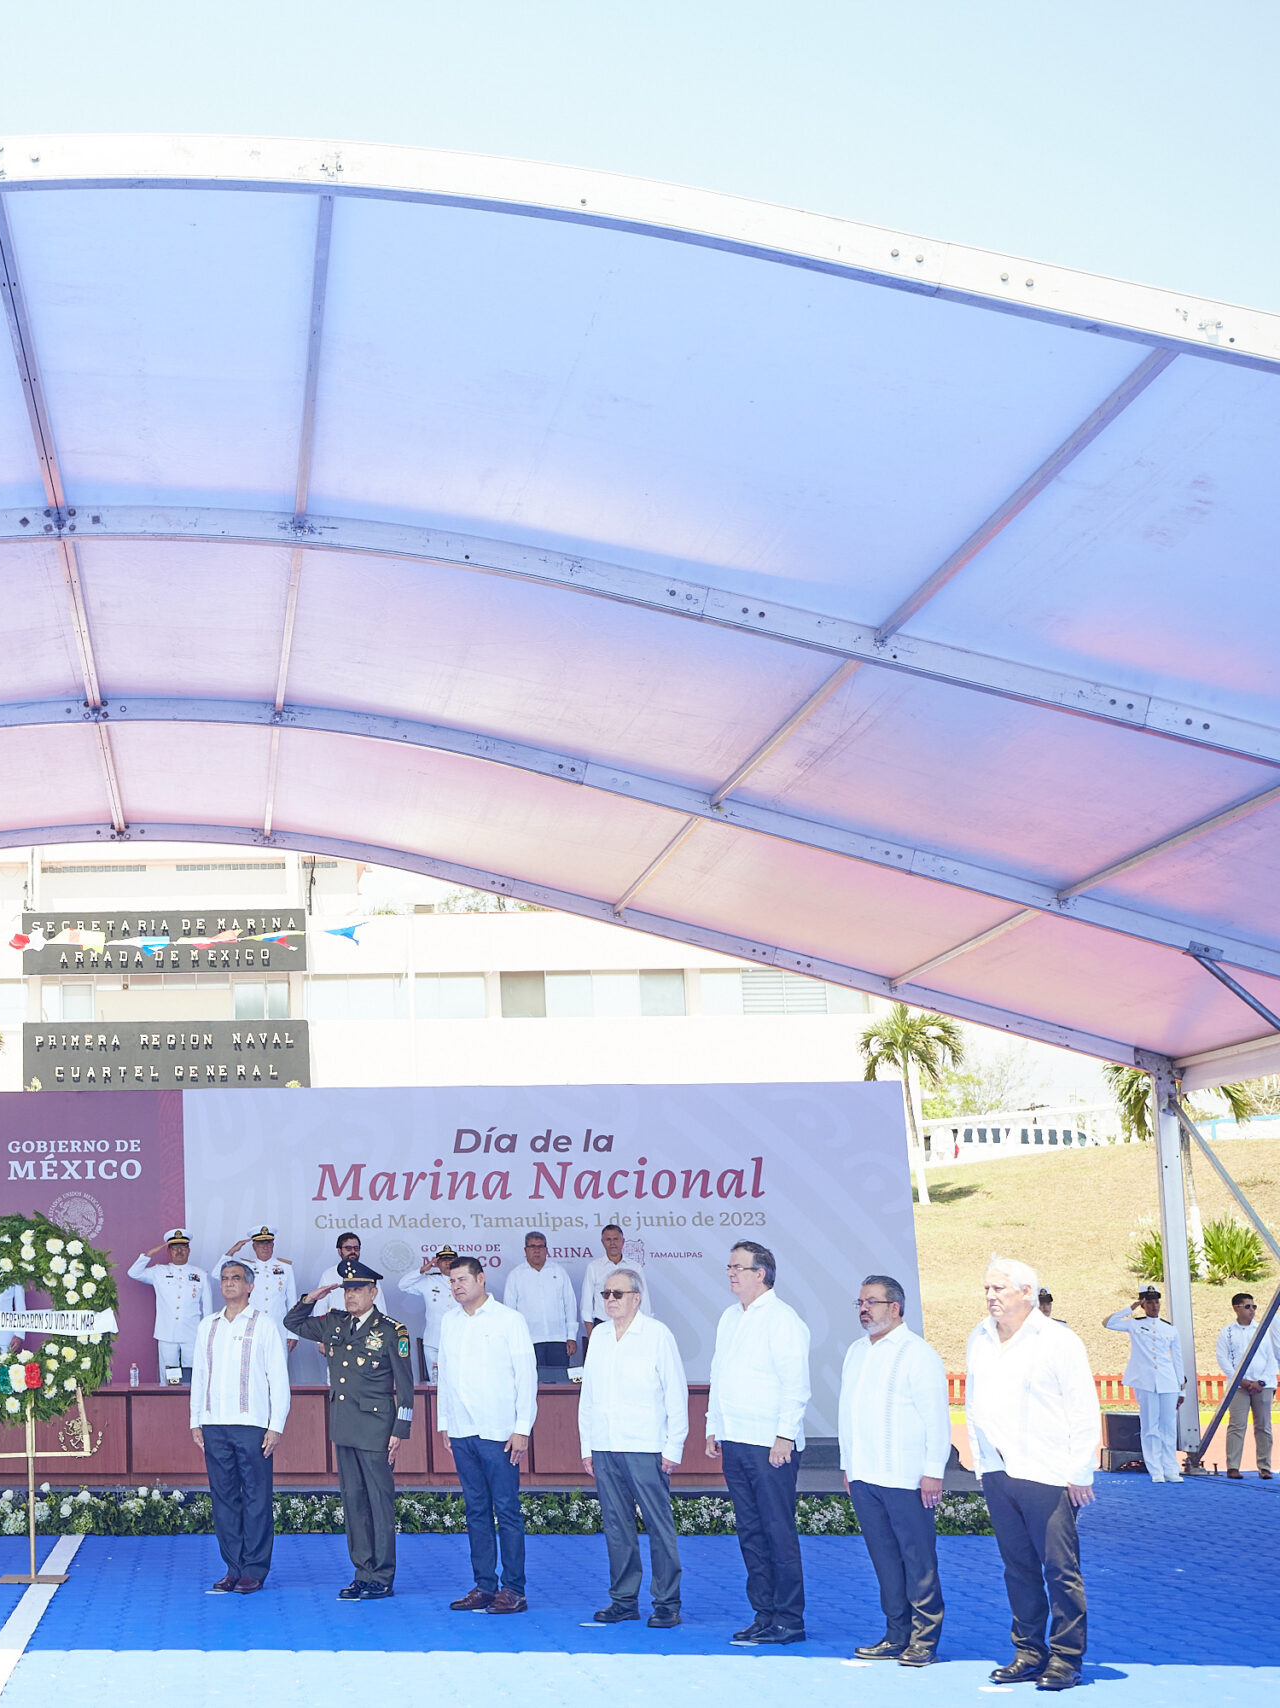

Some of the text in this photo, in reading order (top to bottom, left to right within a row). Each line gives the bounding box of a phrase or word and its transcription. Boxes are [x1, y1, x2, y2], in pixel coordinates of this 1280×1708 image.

[31, 917, 296, 932] SECRETARIA DE MARINA
[60, 948, 270, 963] ARMADA DE MEXICO
[35, 1032, 294, 1046] PRIMERA REGION NAVAL
[55, 1064, 278, 1078] CUARTEL GENERAL
[7, 1139, 141, 1153] GOBIERNO DE
[452, 1126, 614, 1154] Día de la
[7, 1153, 142, 1180] MÉXICO
[311, 1156, 766, 1201] Marina Nacional
[314, 1211, 766, 1231] Ciudad Madero, Tamaulipas, 1 de junio de 2023
[421, 1243, 501, 1252] GORNO DE
[1, 1312, 43, 1329] OFRENDARON
[45, 1313, 53, 1330] SU
[54, 1313, 70, 1331] VIDA
[71, 1313, 79, 1330] AL
[80, 1313, 95, 1331] MAR
